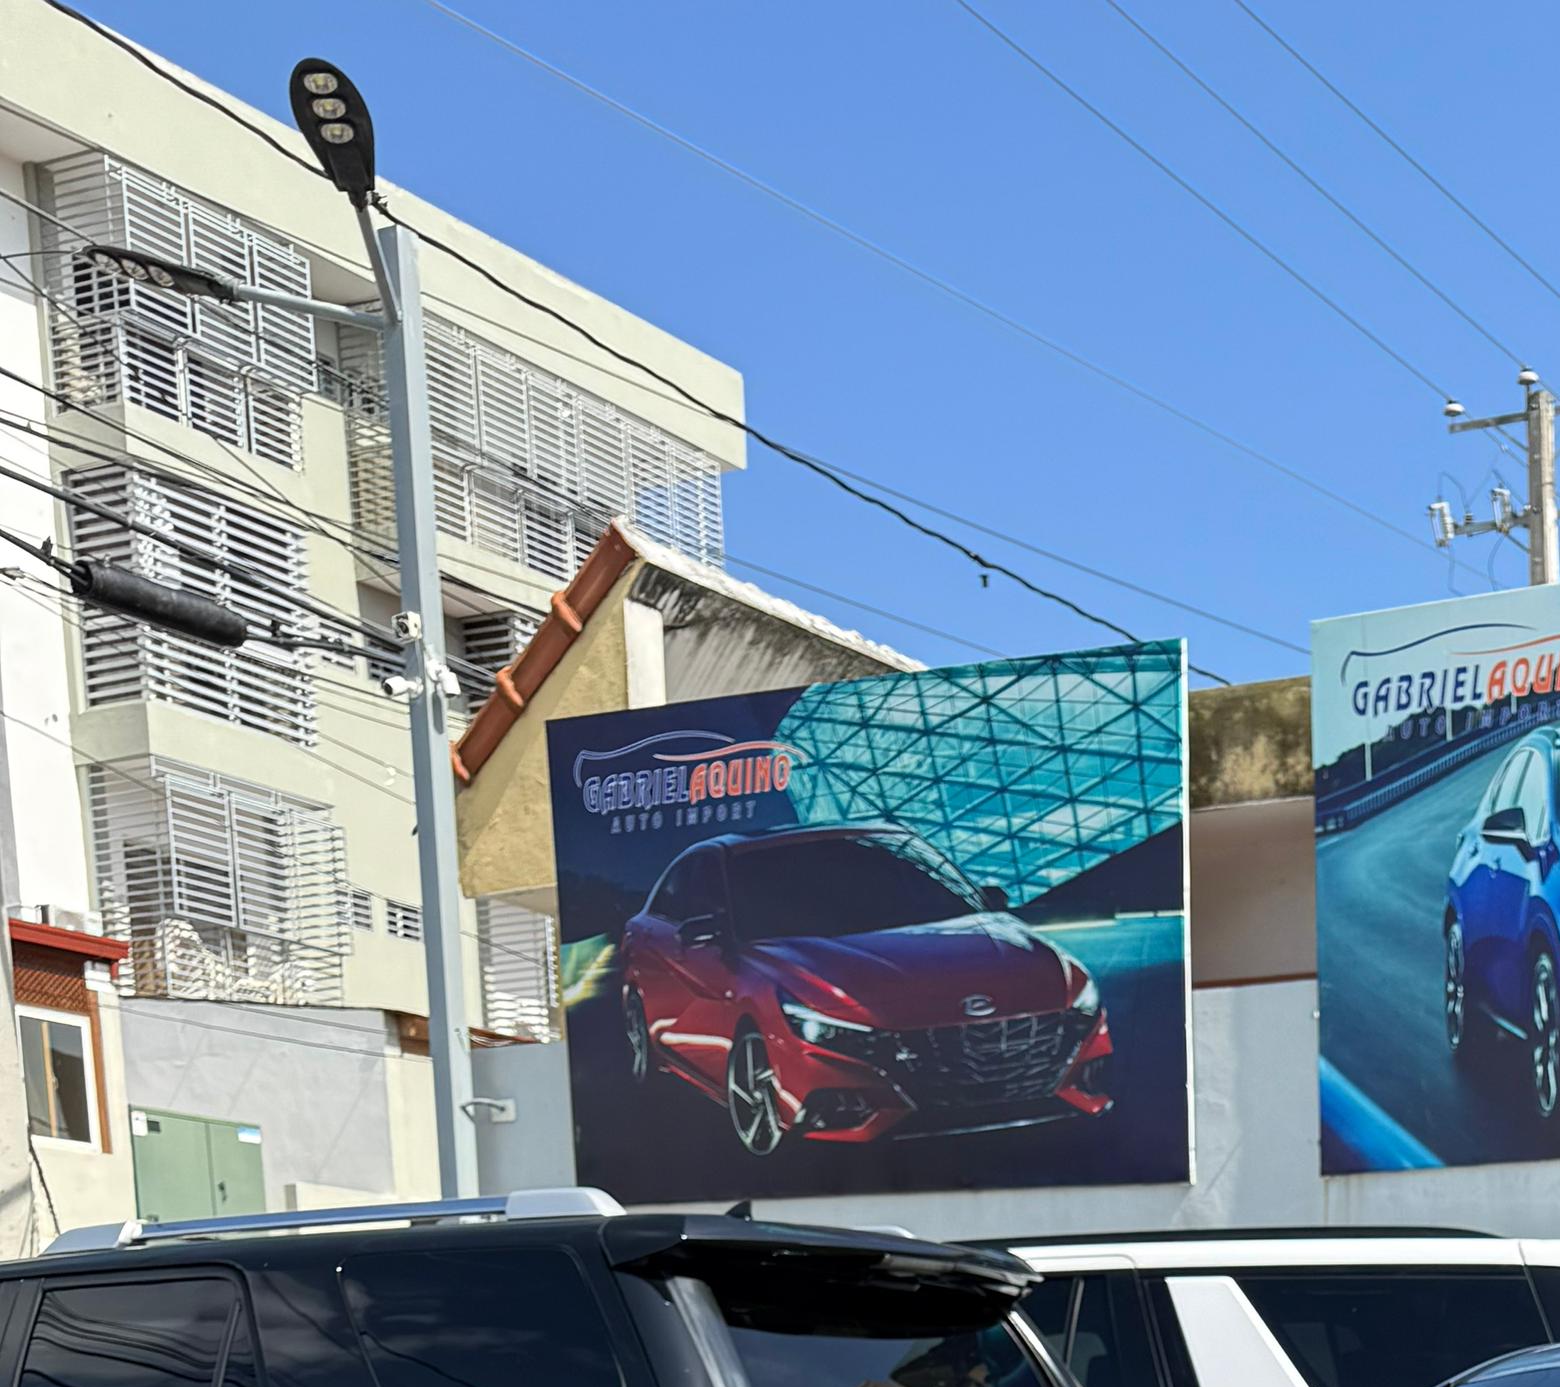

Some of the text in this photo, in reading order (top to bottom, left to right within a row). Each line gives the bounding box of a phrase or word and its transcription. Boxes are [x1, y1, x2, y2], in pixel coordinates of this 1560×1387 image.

[1384, 714, 1446, 742] AUTO
[610, 800, 756, 834] AUTO IMPORT
